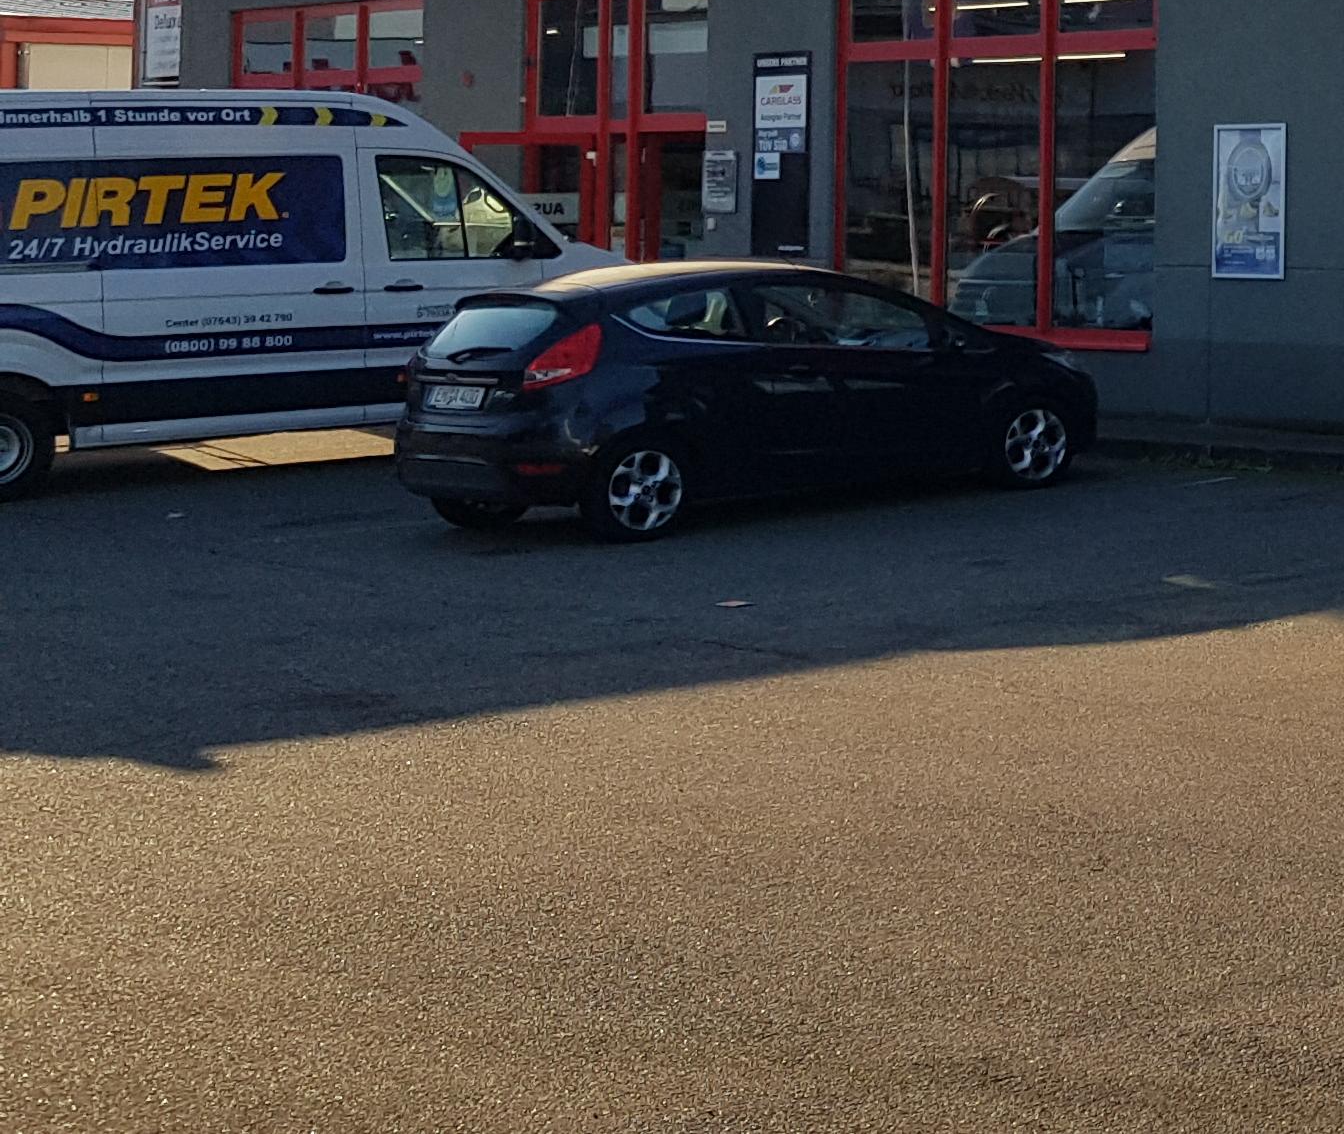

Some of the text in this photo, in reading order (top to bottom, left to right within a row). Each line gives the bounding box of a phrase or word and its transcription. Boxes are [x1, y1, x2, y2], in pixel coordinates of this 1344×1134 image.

[0, 109, 251, 123] Innerhalb 1 Stunde vor Ort
[8, 172, 287, 231] PIRTEK
[8, 230, 283, 260] 24/7 HydraulikService
[165, 319, 199, 328] Center
[164, 335, 293, 353] (0800) 99 88 800
